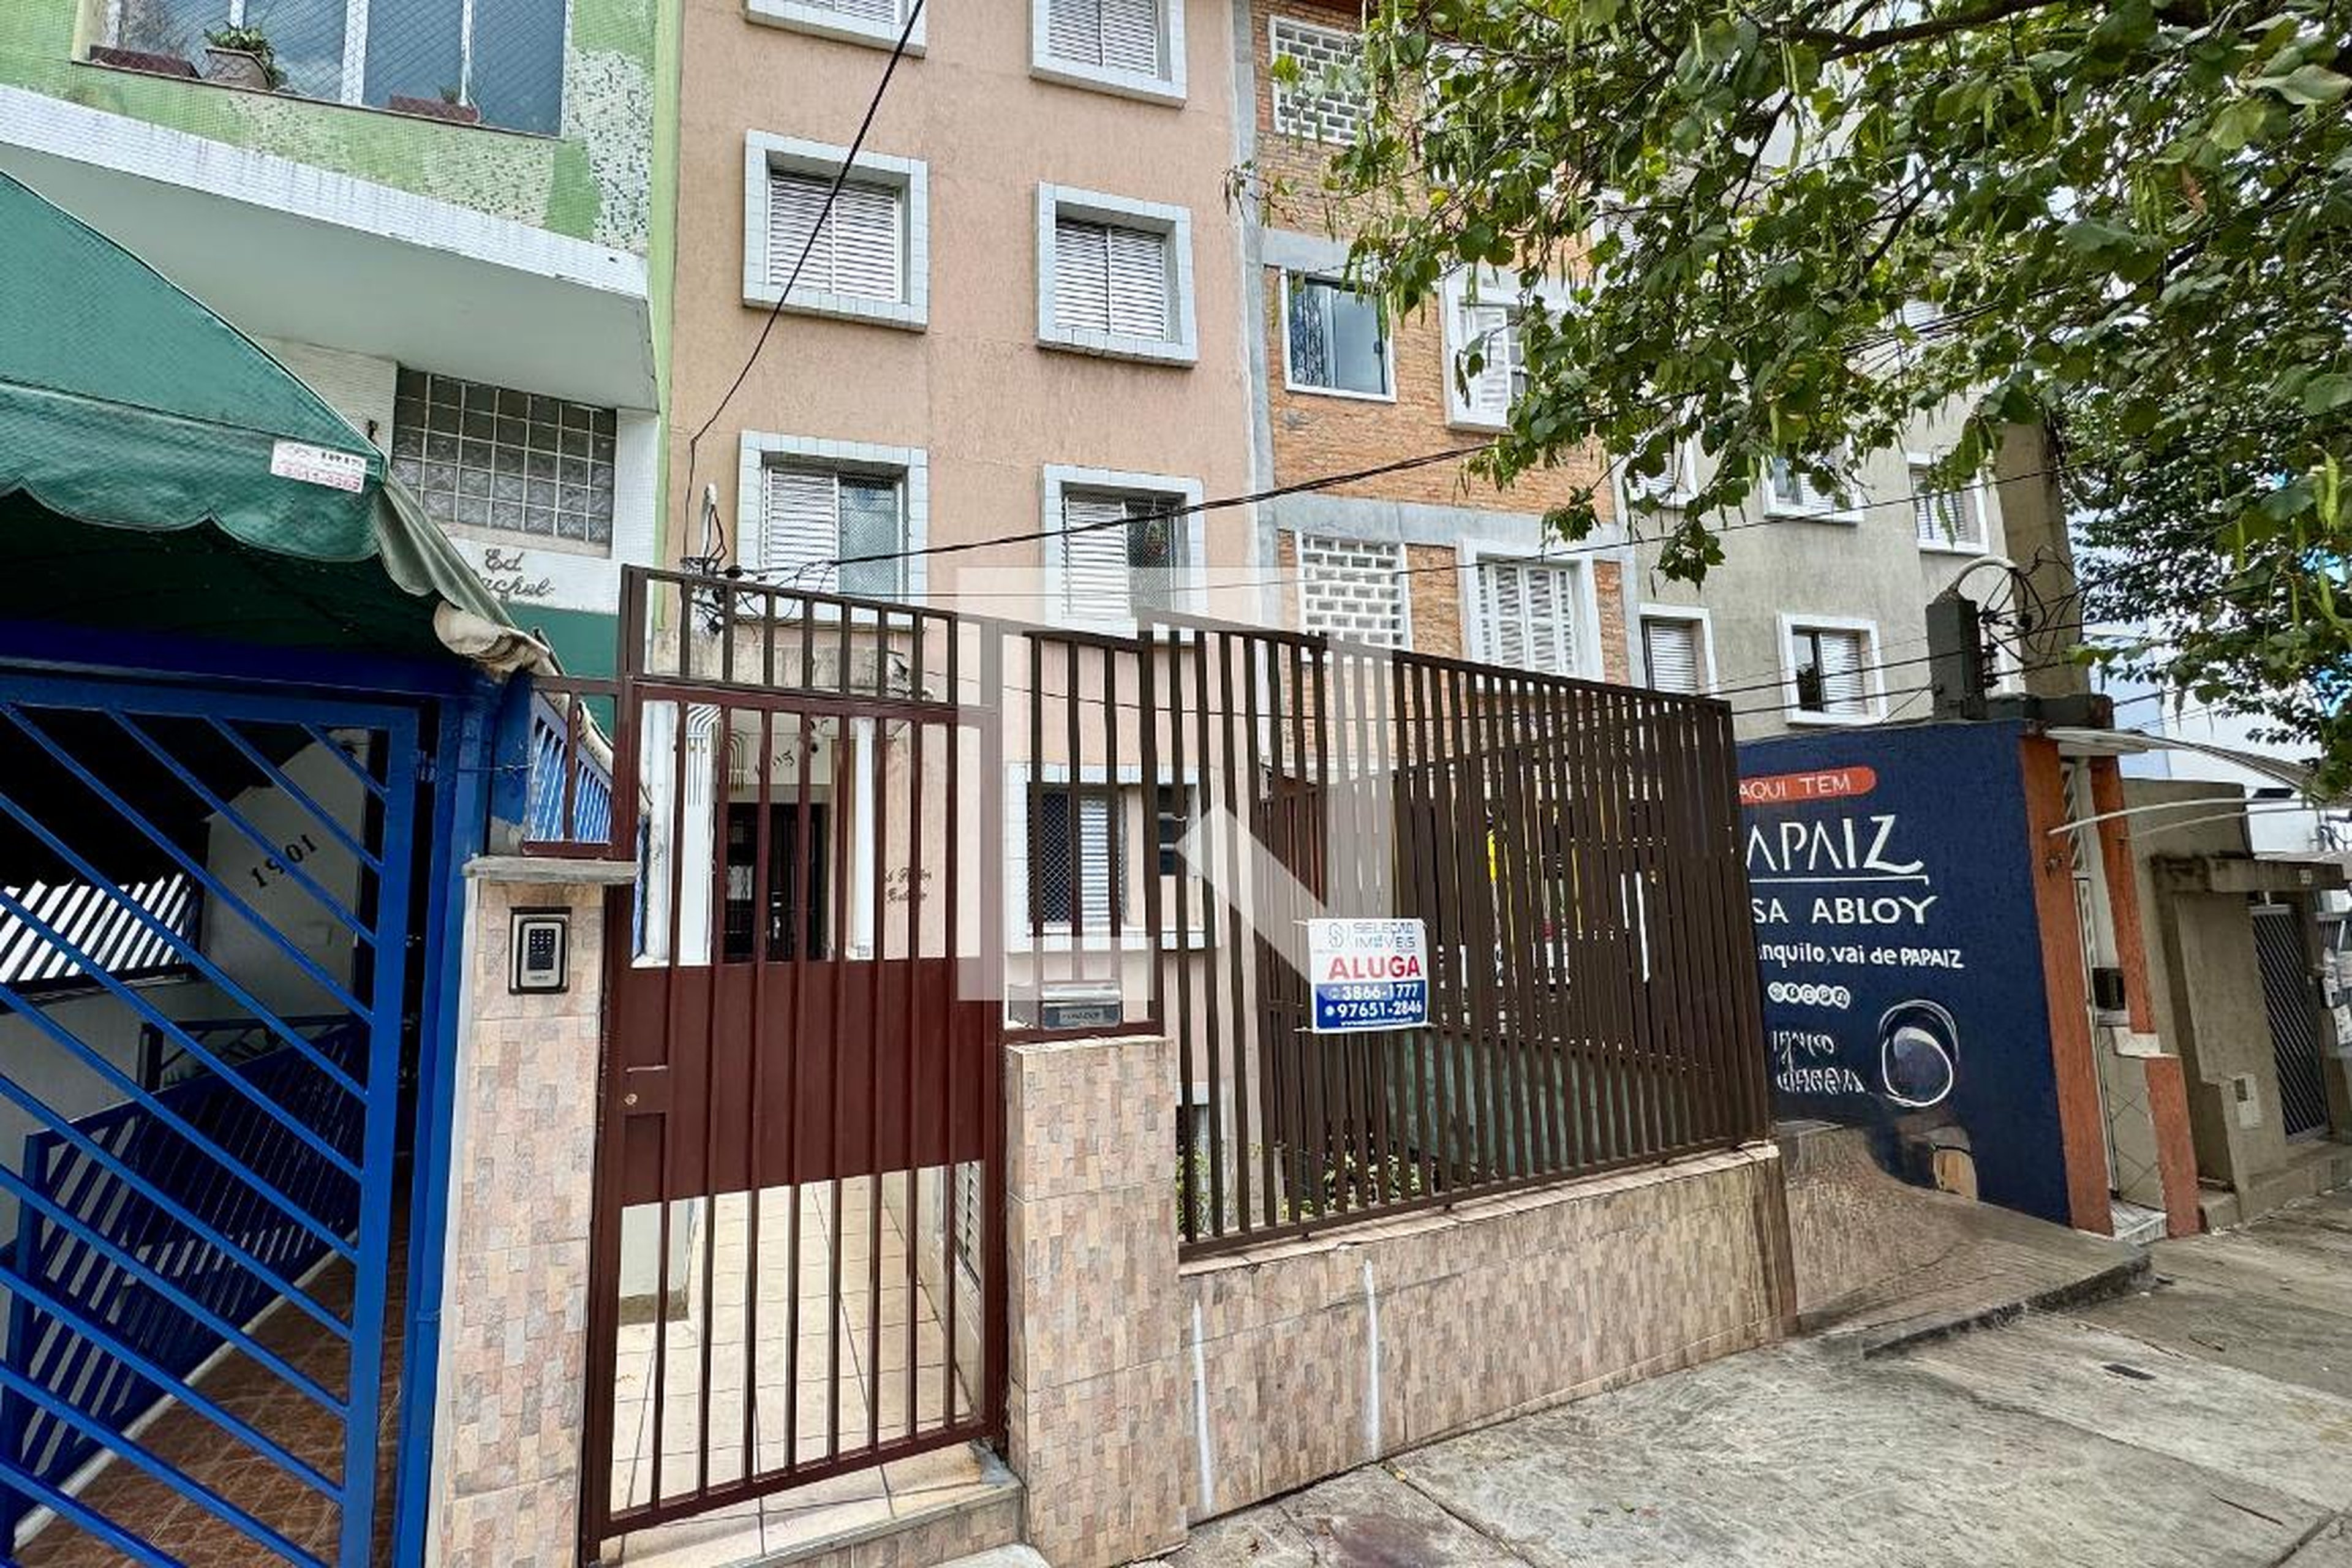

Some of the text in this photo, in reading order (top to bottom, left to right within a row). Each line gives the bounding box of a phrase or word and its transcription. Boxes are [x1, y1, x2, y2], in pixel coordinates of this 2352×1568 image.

[480, 575, 556, 601] achel
[1739, 773, 1851, 801] AQUI TEM
[1746, 814, 1924, 875] APAIZ
[1751, 895, 1939, 924] SA ABLOY
[1328, 955, 1422, 979] ALUGA
[1758, 942, 1965, 968] nquilo, vai de PAPAIZ
